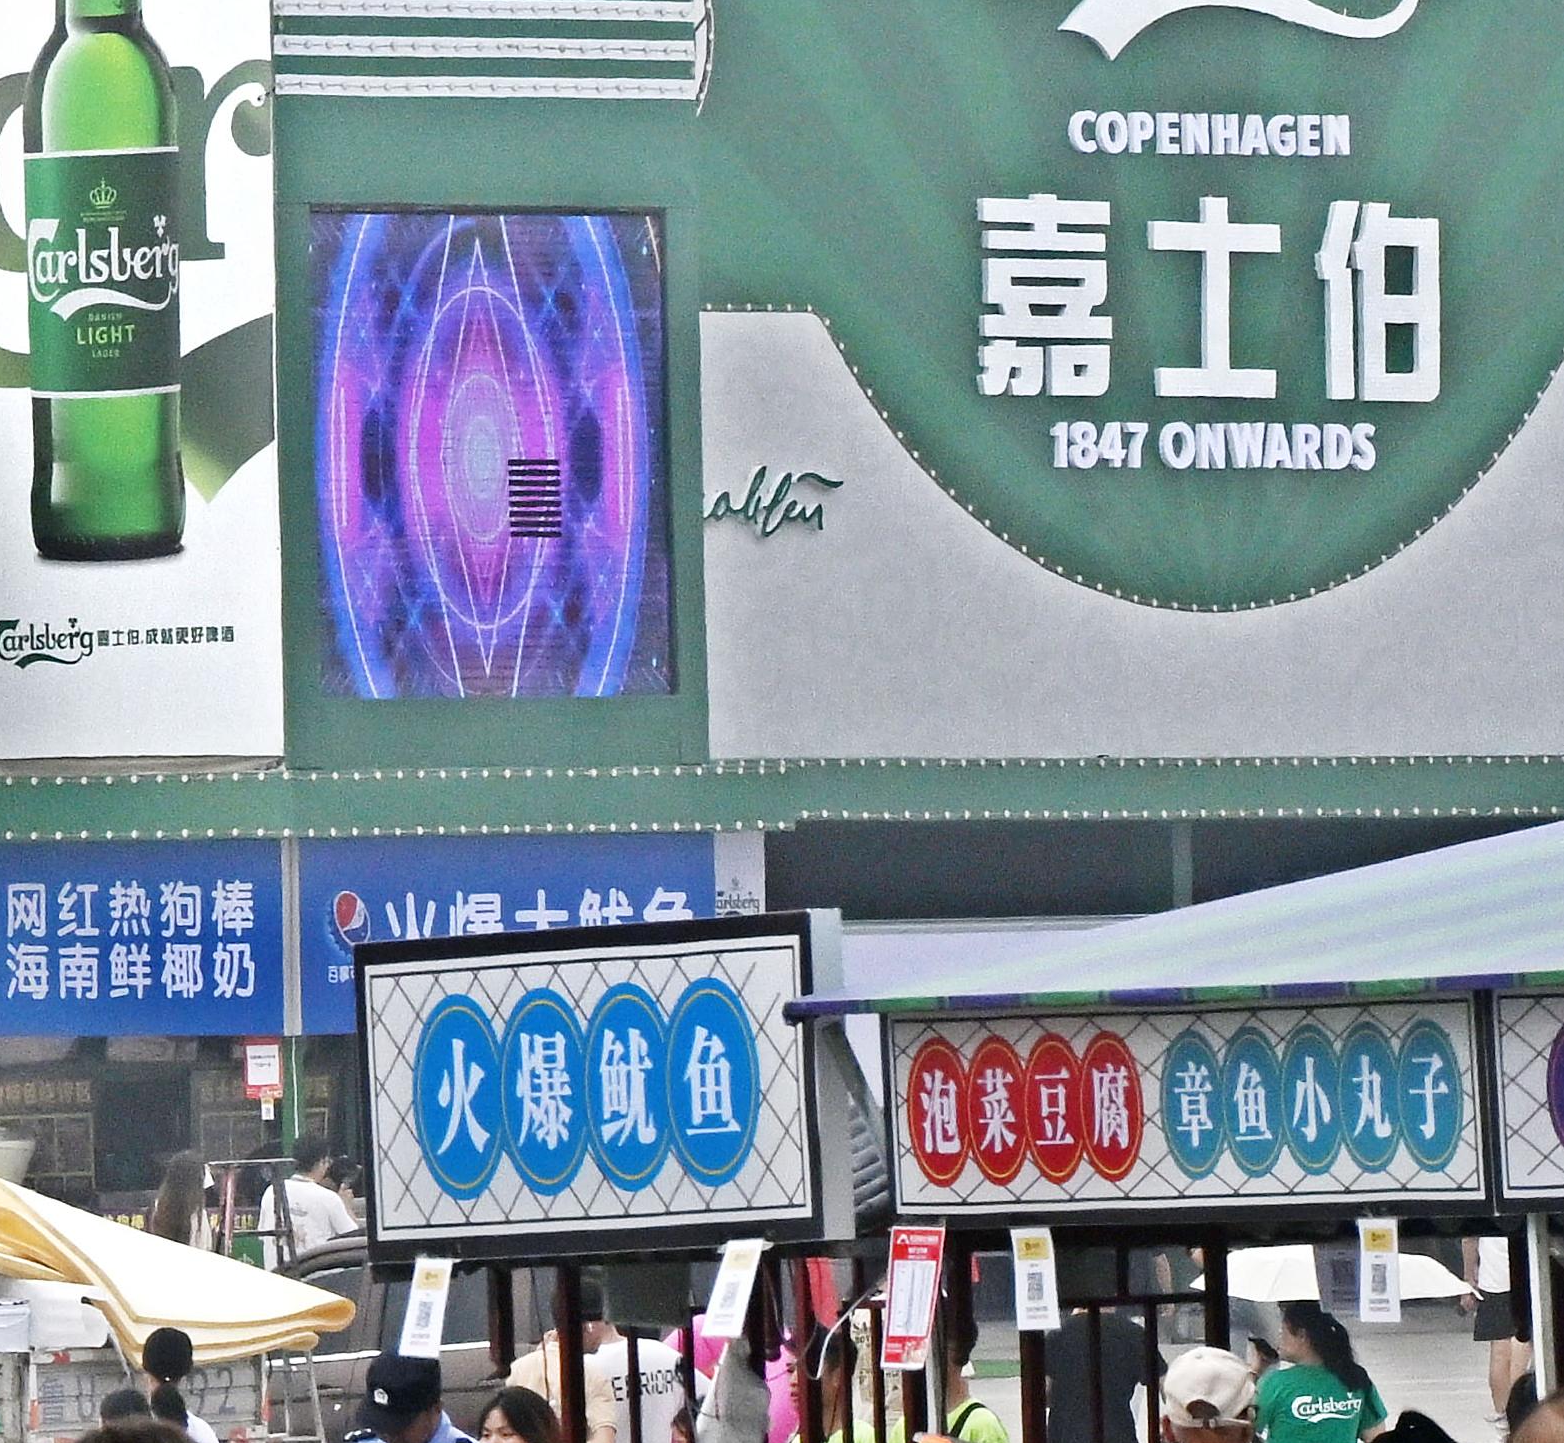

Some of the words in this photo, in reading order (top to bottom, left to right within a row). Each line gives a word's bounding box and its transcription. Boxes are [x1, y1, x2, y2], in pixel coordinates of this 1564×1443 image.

[1068, 111, 1350, 158] COPENHAGEN
[27, 218, 180, 313] Carlsberg
[976, 193, 1442, 404] 嘉士伯
[77, 324, 135, 345] LIGHT
[1050, 419, 1149, 470] 1847
[1160, 421, 1377, 472] ONWARDS
[6, 879, 255, 938] 网红热狗棒
[6, 942, 255, 999] 海南鲜椰奶
[436, 1024, 742, 1157] 火爆鱿鱼
[919, 1066, 1131, 1156] 泡菜豆腐
[1174, 1051, 1450, 1150] 章鱼小丸子
[1292, 1392, 1362, 1423] Carlsberg
